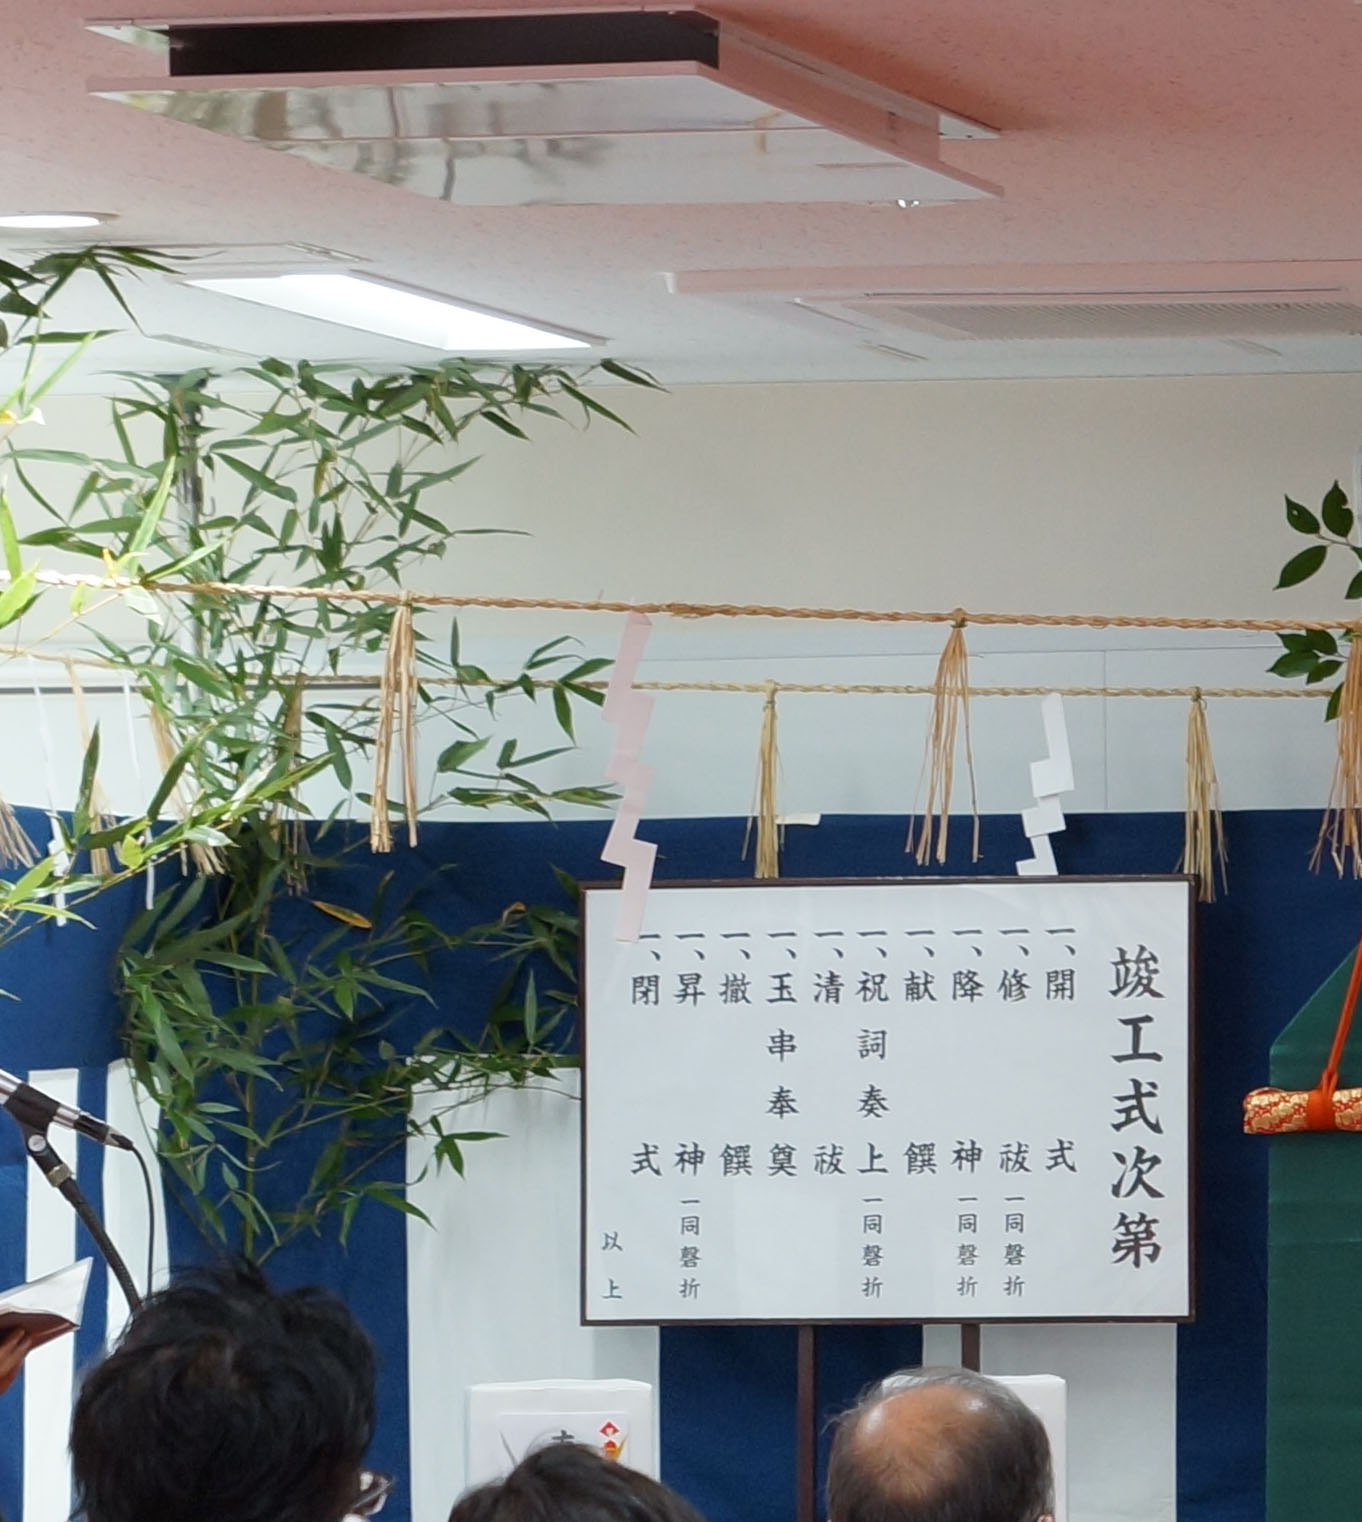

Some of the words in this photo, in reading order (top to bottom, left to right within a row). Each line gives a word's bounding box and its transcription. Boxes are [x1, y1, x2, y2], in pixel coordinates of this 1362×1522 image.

[1109, 944, 1165, 1269] 竣工式次第
[602, 1232, 622, 1299] 以上
